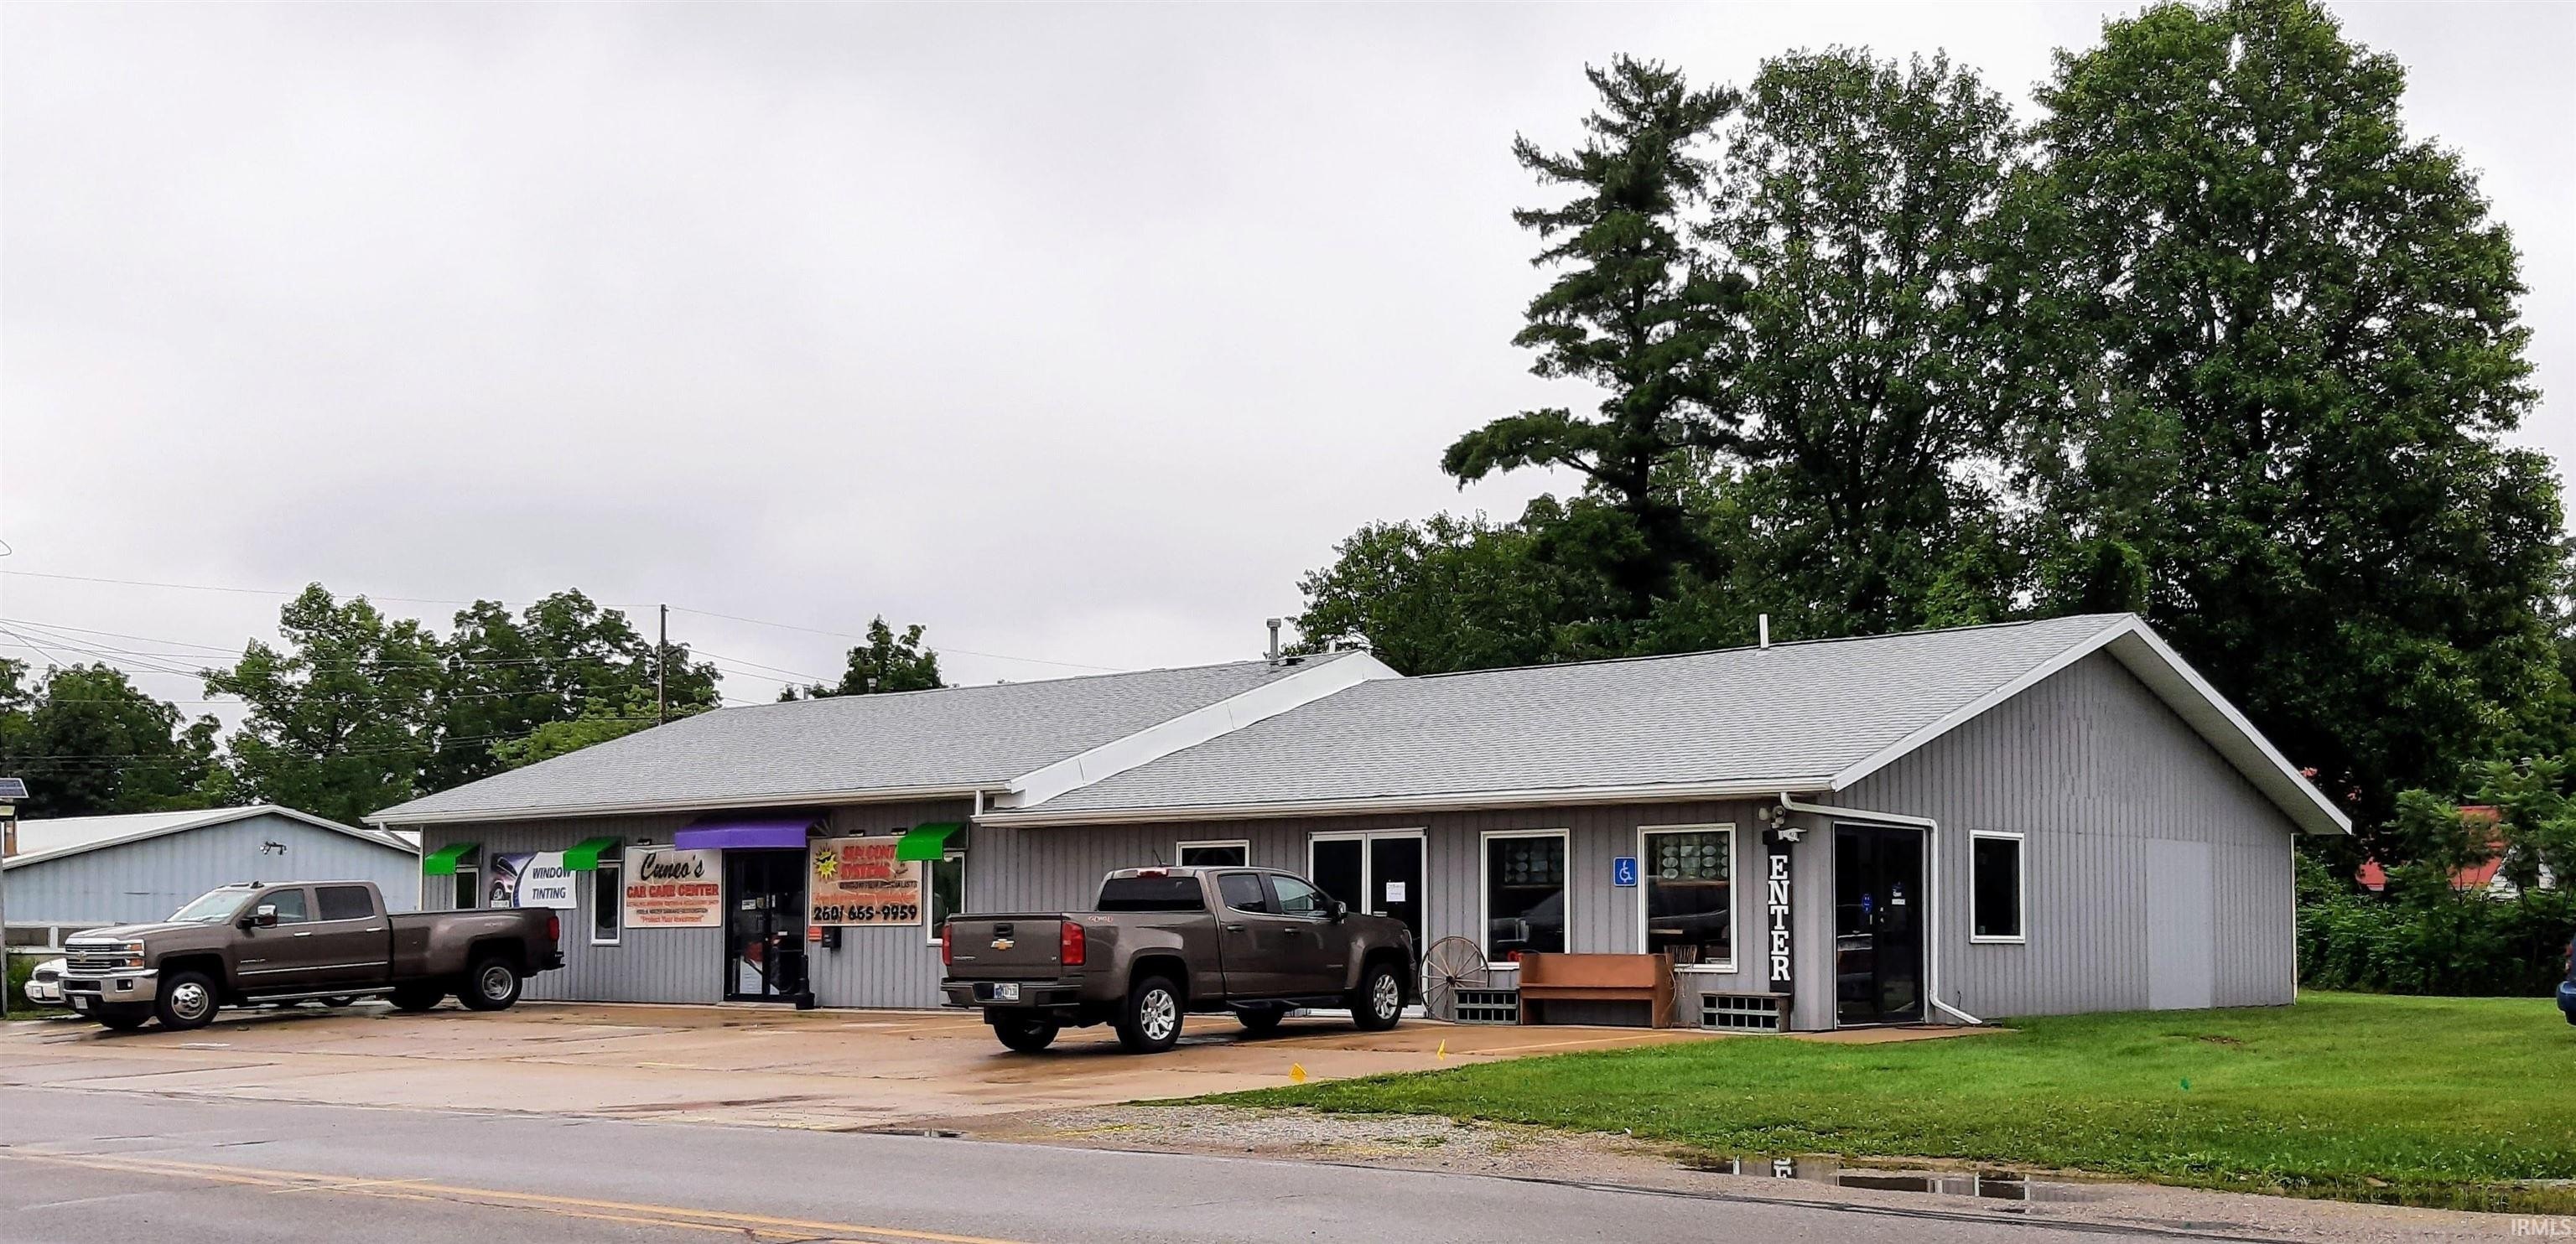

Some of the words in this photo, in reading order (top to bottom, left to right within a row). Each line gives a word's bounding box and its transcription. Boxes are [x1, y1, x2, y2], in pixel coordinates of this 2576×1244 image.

[532, 866, 570, 879] WINDOW
[641, 852, 705, 881] Cuneo's
[532, 887, 565, 899] TINTING
[626, 885, 647, 898] CAR
[678, 883, 719, 896] CENTER
[848, 904, 917, 920] 665-9959
[1768, 855, 1790, 981] ENTER
